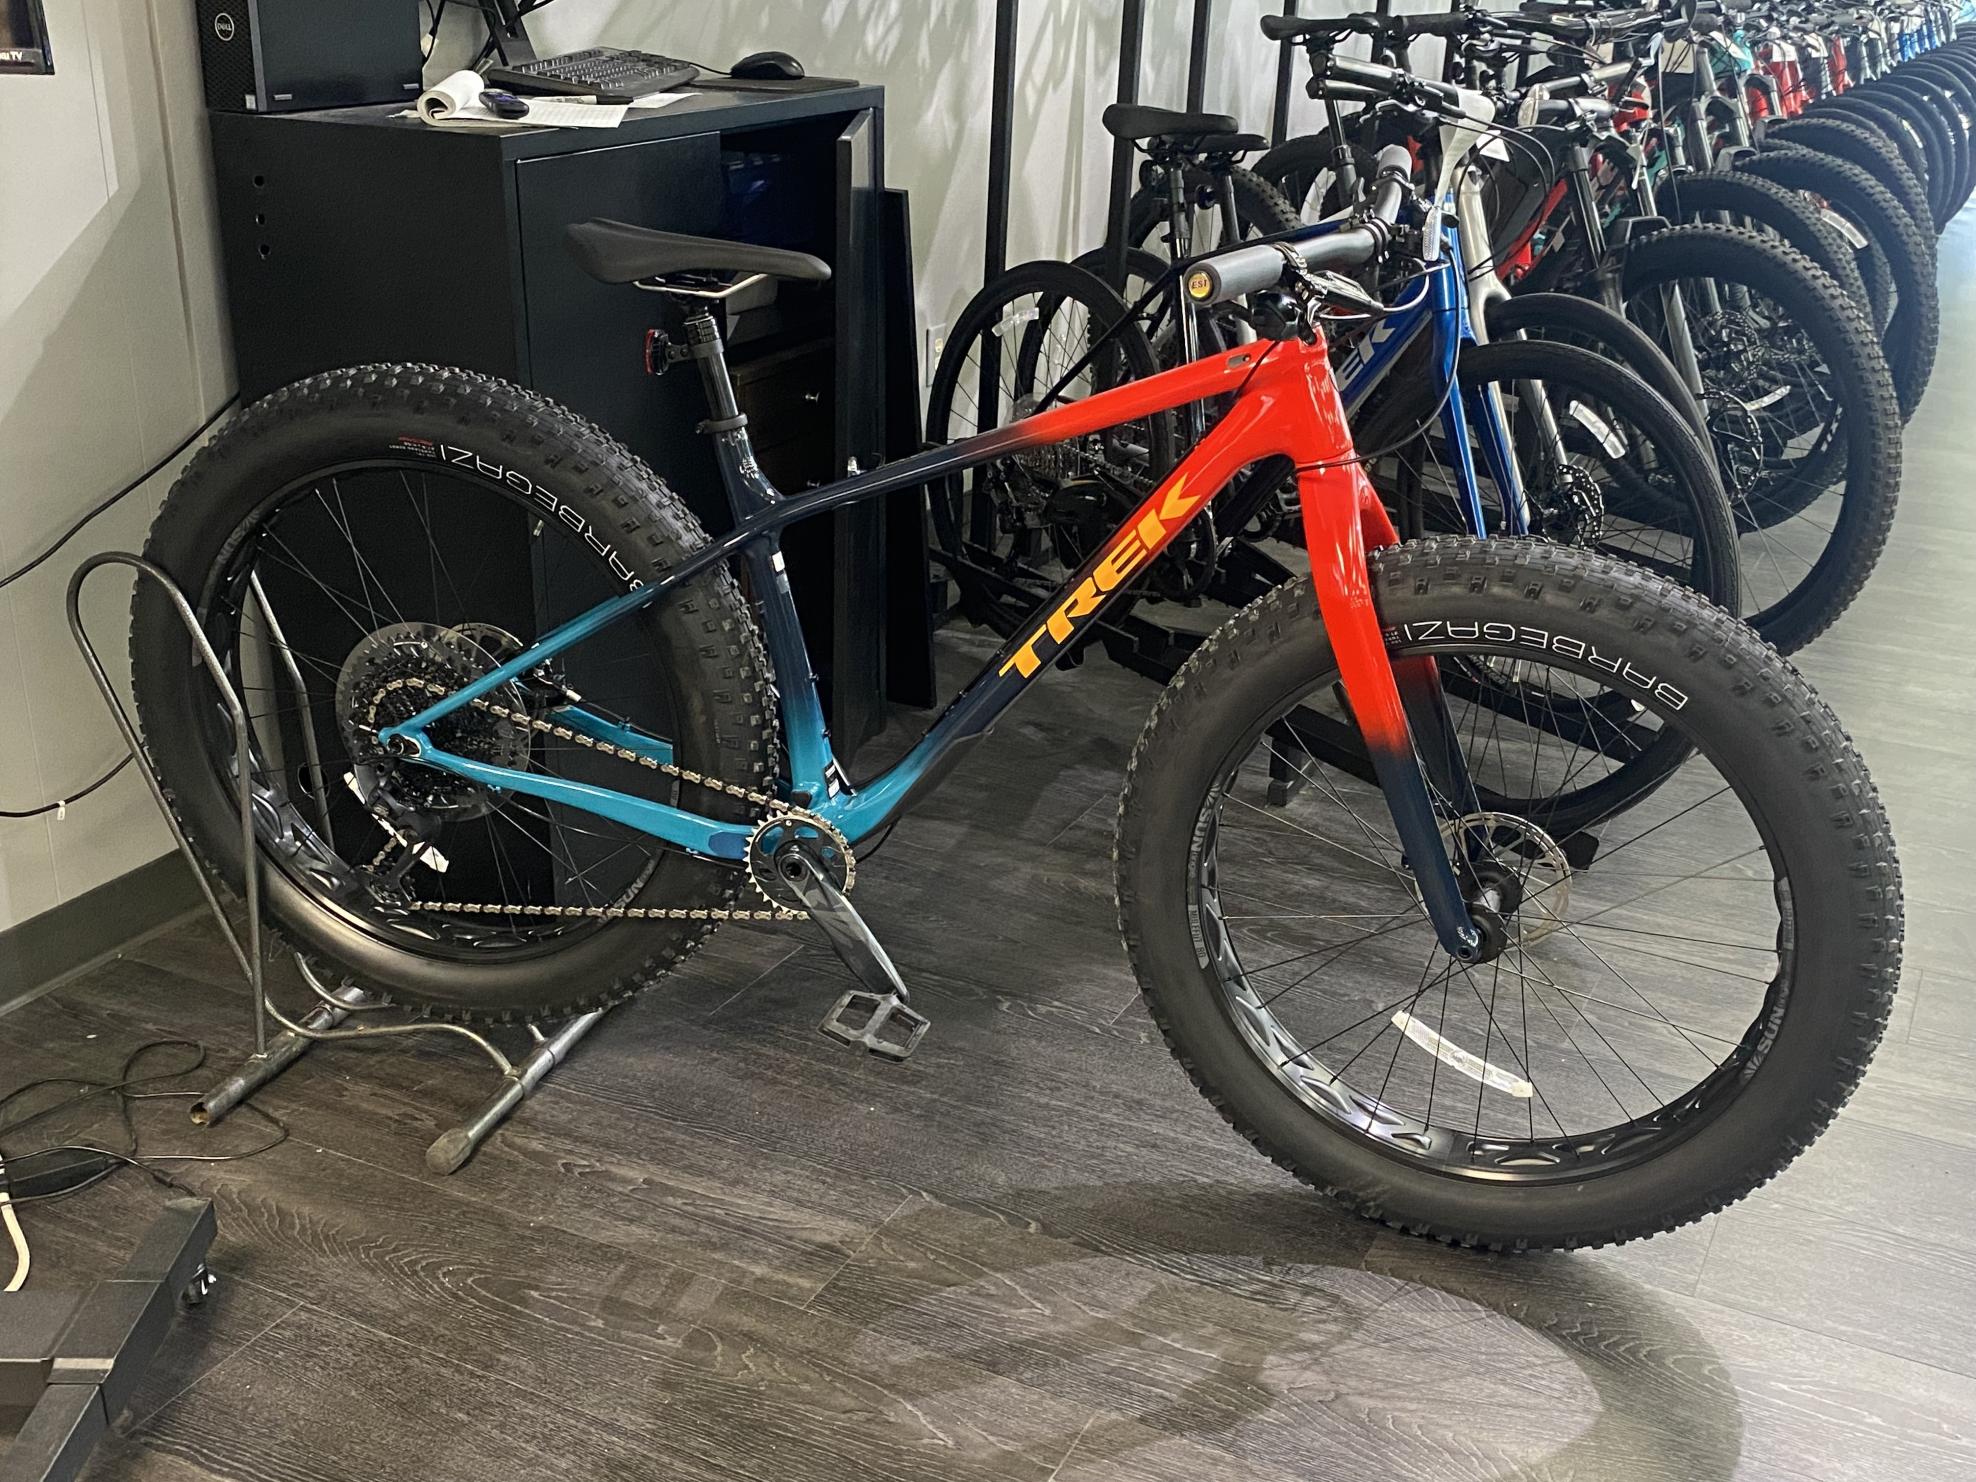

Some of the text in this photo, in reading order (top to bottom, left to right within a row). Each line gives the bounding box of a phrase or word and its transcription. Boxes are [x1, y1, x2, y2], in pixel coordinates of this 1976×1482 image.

[217, 23, 232, 31] DELL
[10, 51, 23, 62] TV
[1191, 279, 1208, 290] ESI
[1335, 318, 1396, 391] EK
[998, 472, 1201, 679] TREK
[1404, 620, 1689, 711] BARBEGAZI
